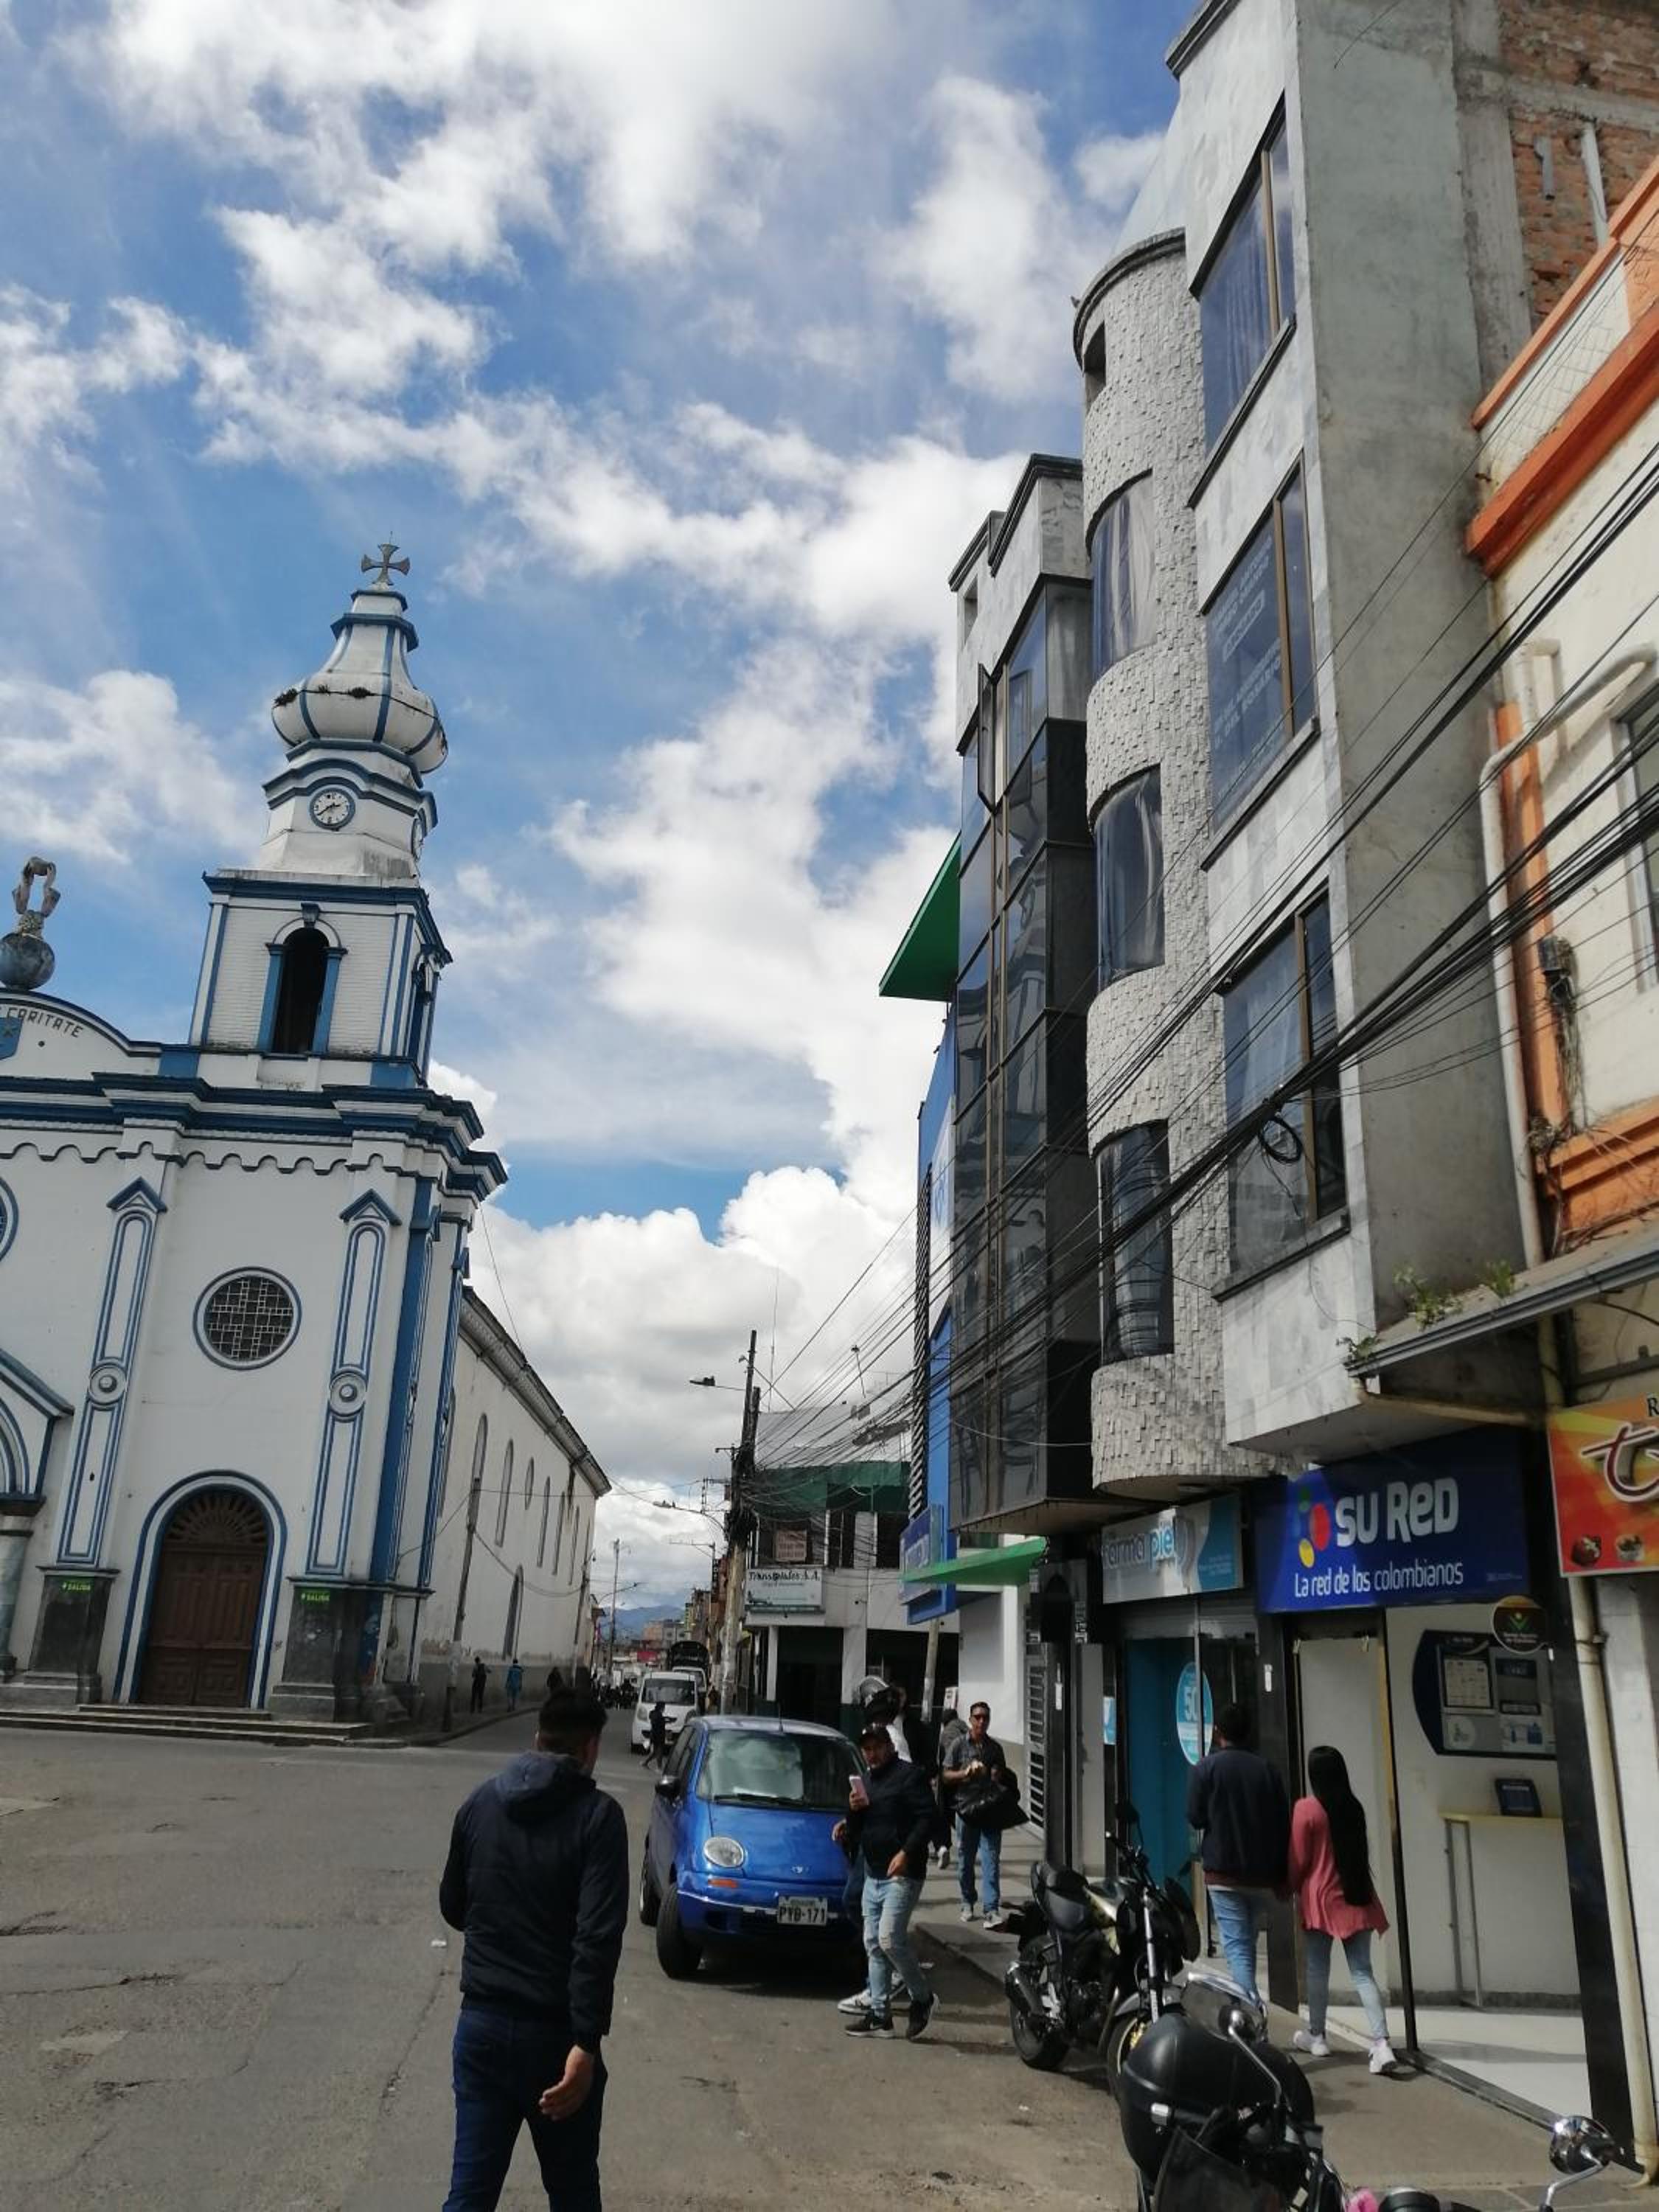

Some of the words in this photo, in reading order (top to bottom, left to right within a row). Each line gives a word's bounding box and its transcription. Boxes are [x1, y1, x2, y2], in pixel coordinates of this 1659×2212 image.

[6, 1007, 83, 1038] CARITATE
[1335, 1492, 1379, 1548] SU
[1295, 1573, 1309, 1598] La
[1311, 1567, 1332, 1596] red
[1334, 1565, 1349, 1595] de
[1352, 1563, 1371, 1593] los
[1373, 1559, 1464, 1591] colombianos
